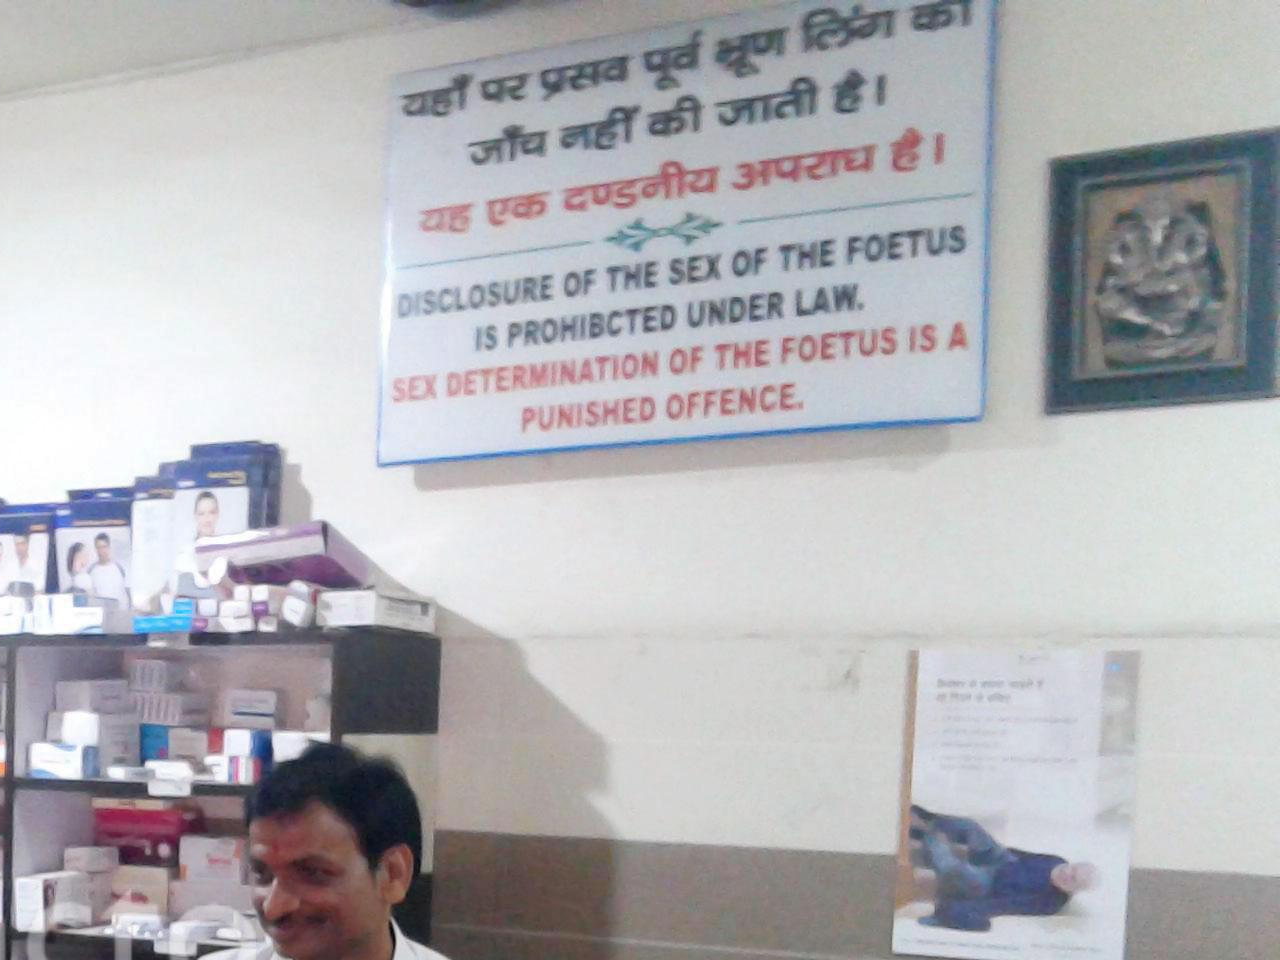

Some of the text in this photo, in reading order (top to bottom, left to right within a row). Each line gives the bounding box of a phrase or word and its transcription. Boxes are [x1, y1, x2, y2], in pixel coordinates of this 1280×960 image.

[400, 73, 472, 117] यहाँ
[481, 73, 528, 102] पर
[540, 56, 634, 100] प्रसव
[643, 30, 703, 91] पूर्व
[714, 27, 790, 78] भ्रूण
[801, 5, 896, 52] लिंग
[468, 124, 548, 165] जाँच
[559, 105, 641, 150] नहीं
[647, 94, 703, 135] की
[714, 77, 818, 126] जाती
[419, 203, 474, 232] यह
[485, 191, 552, 226] एक
[560, 161, 720, 211] दण्डनीय
[731, 144, 877, 190] अपराध
[397, 225, 966, 318] DISCLOSURE OF THE SEX OF THE FOETUS
[476, 283, 865, 351] IS PROHIBCTED UNDER LAW.
[392, 321, 967, 402] SEX DETERMINATION OF THE FOETUS IS A
[521, 383, 804, 433] PUNISHED OFFENCE.
